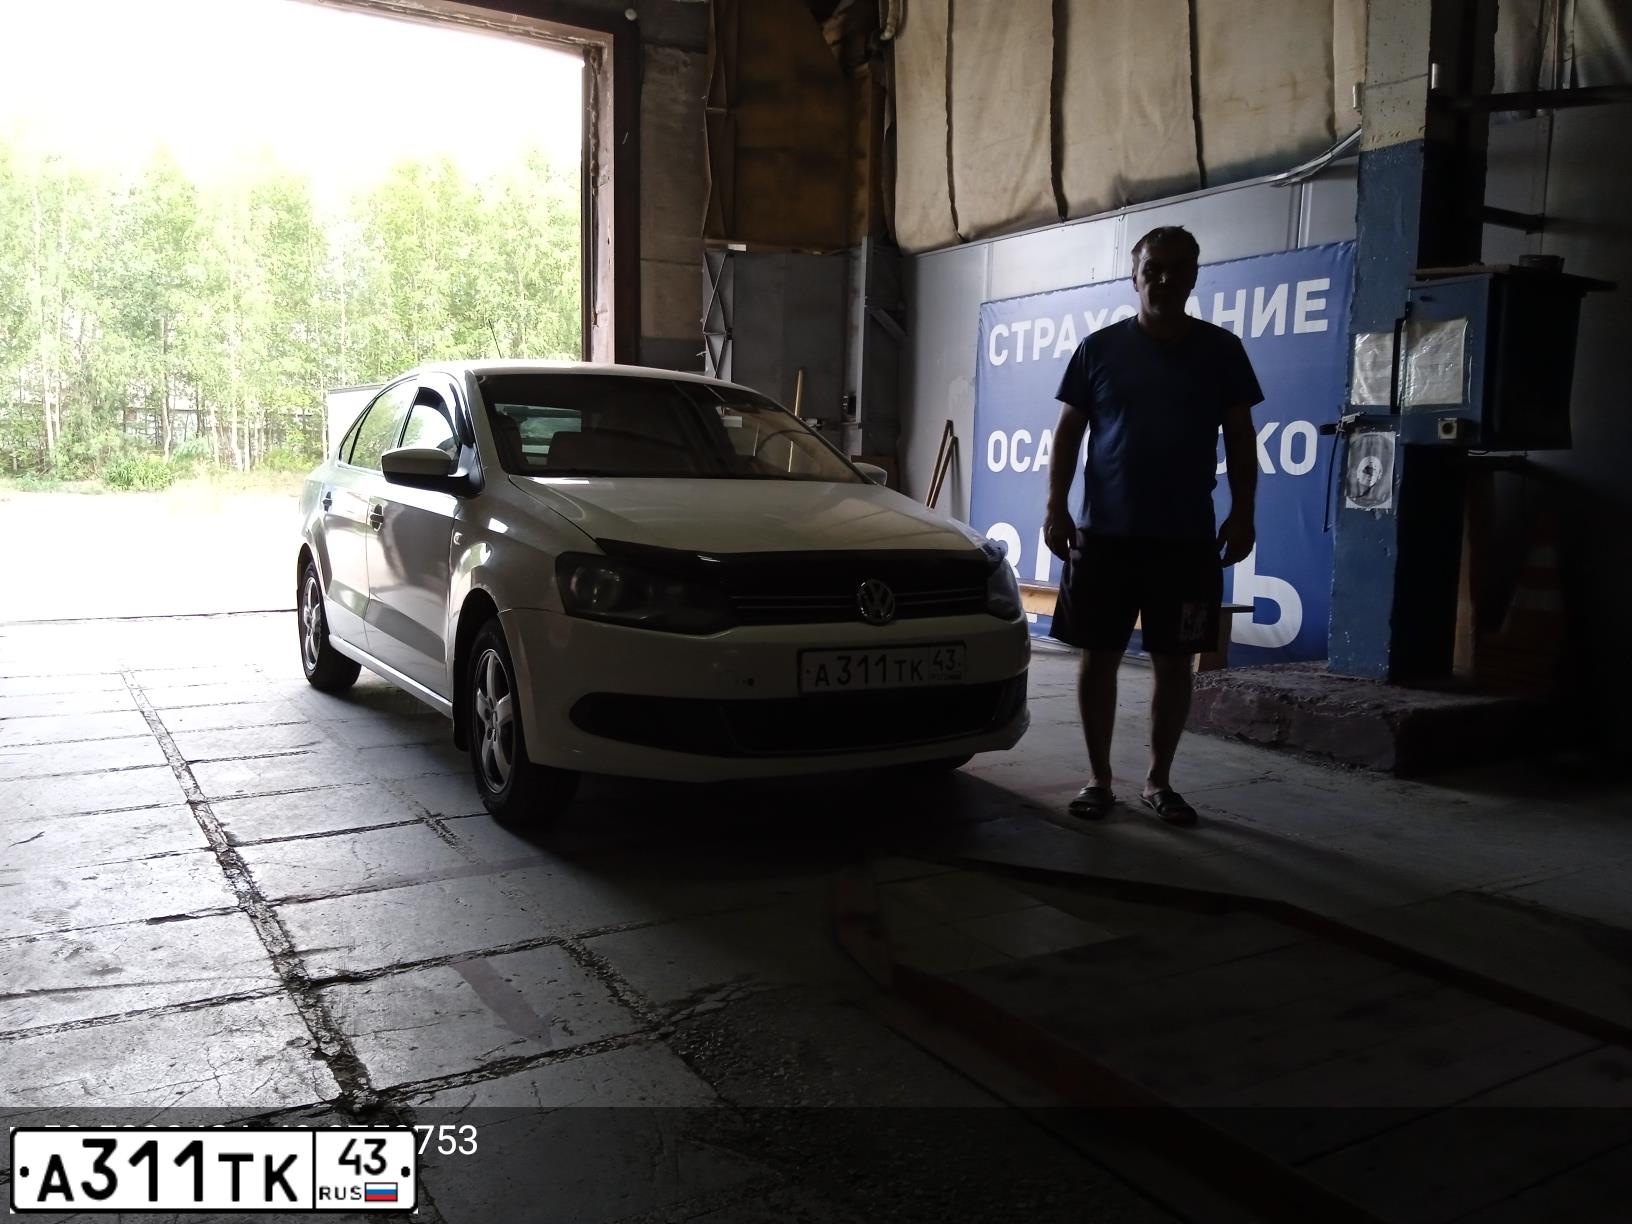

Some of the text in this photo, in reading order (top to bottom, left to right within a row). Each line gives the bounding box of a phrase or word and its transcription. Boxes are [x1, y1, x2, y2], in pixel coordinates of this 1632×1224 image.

[989, 278, 1331, 365] СТРАНИЕ
[987, 429, 1053, 473] ОСА
[815, 649, 955, 686] А311ТК 43
